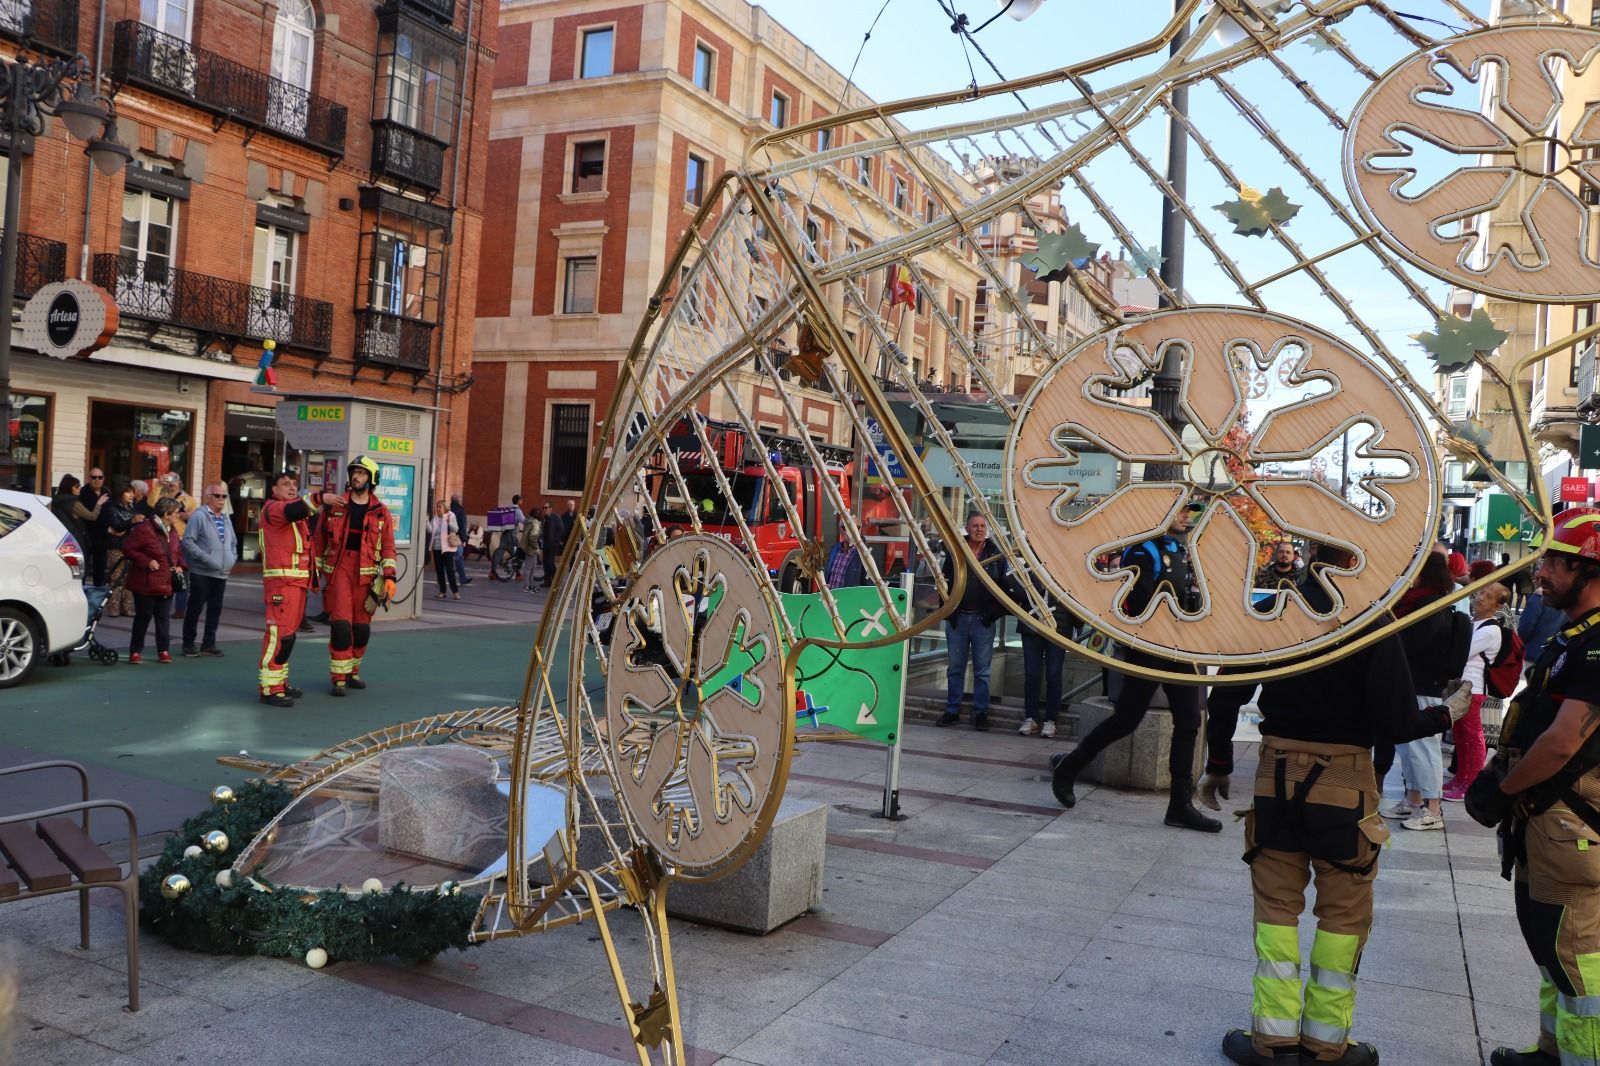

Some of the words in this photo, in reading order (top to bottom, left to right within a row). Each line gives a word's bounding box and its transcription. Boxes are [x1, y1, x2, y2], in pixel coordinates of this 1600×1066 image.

[311, 407, 342, 419] ONCE
[381, 439, 410, 452] ONCE
[971, 460, 1001, 470] Entrada
[1068, 467, 1103, 479] empark
[1562, 483, 1587, 492] GAES
